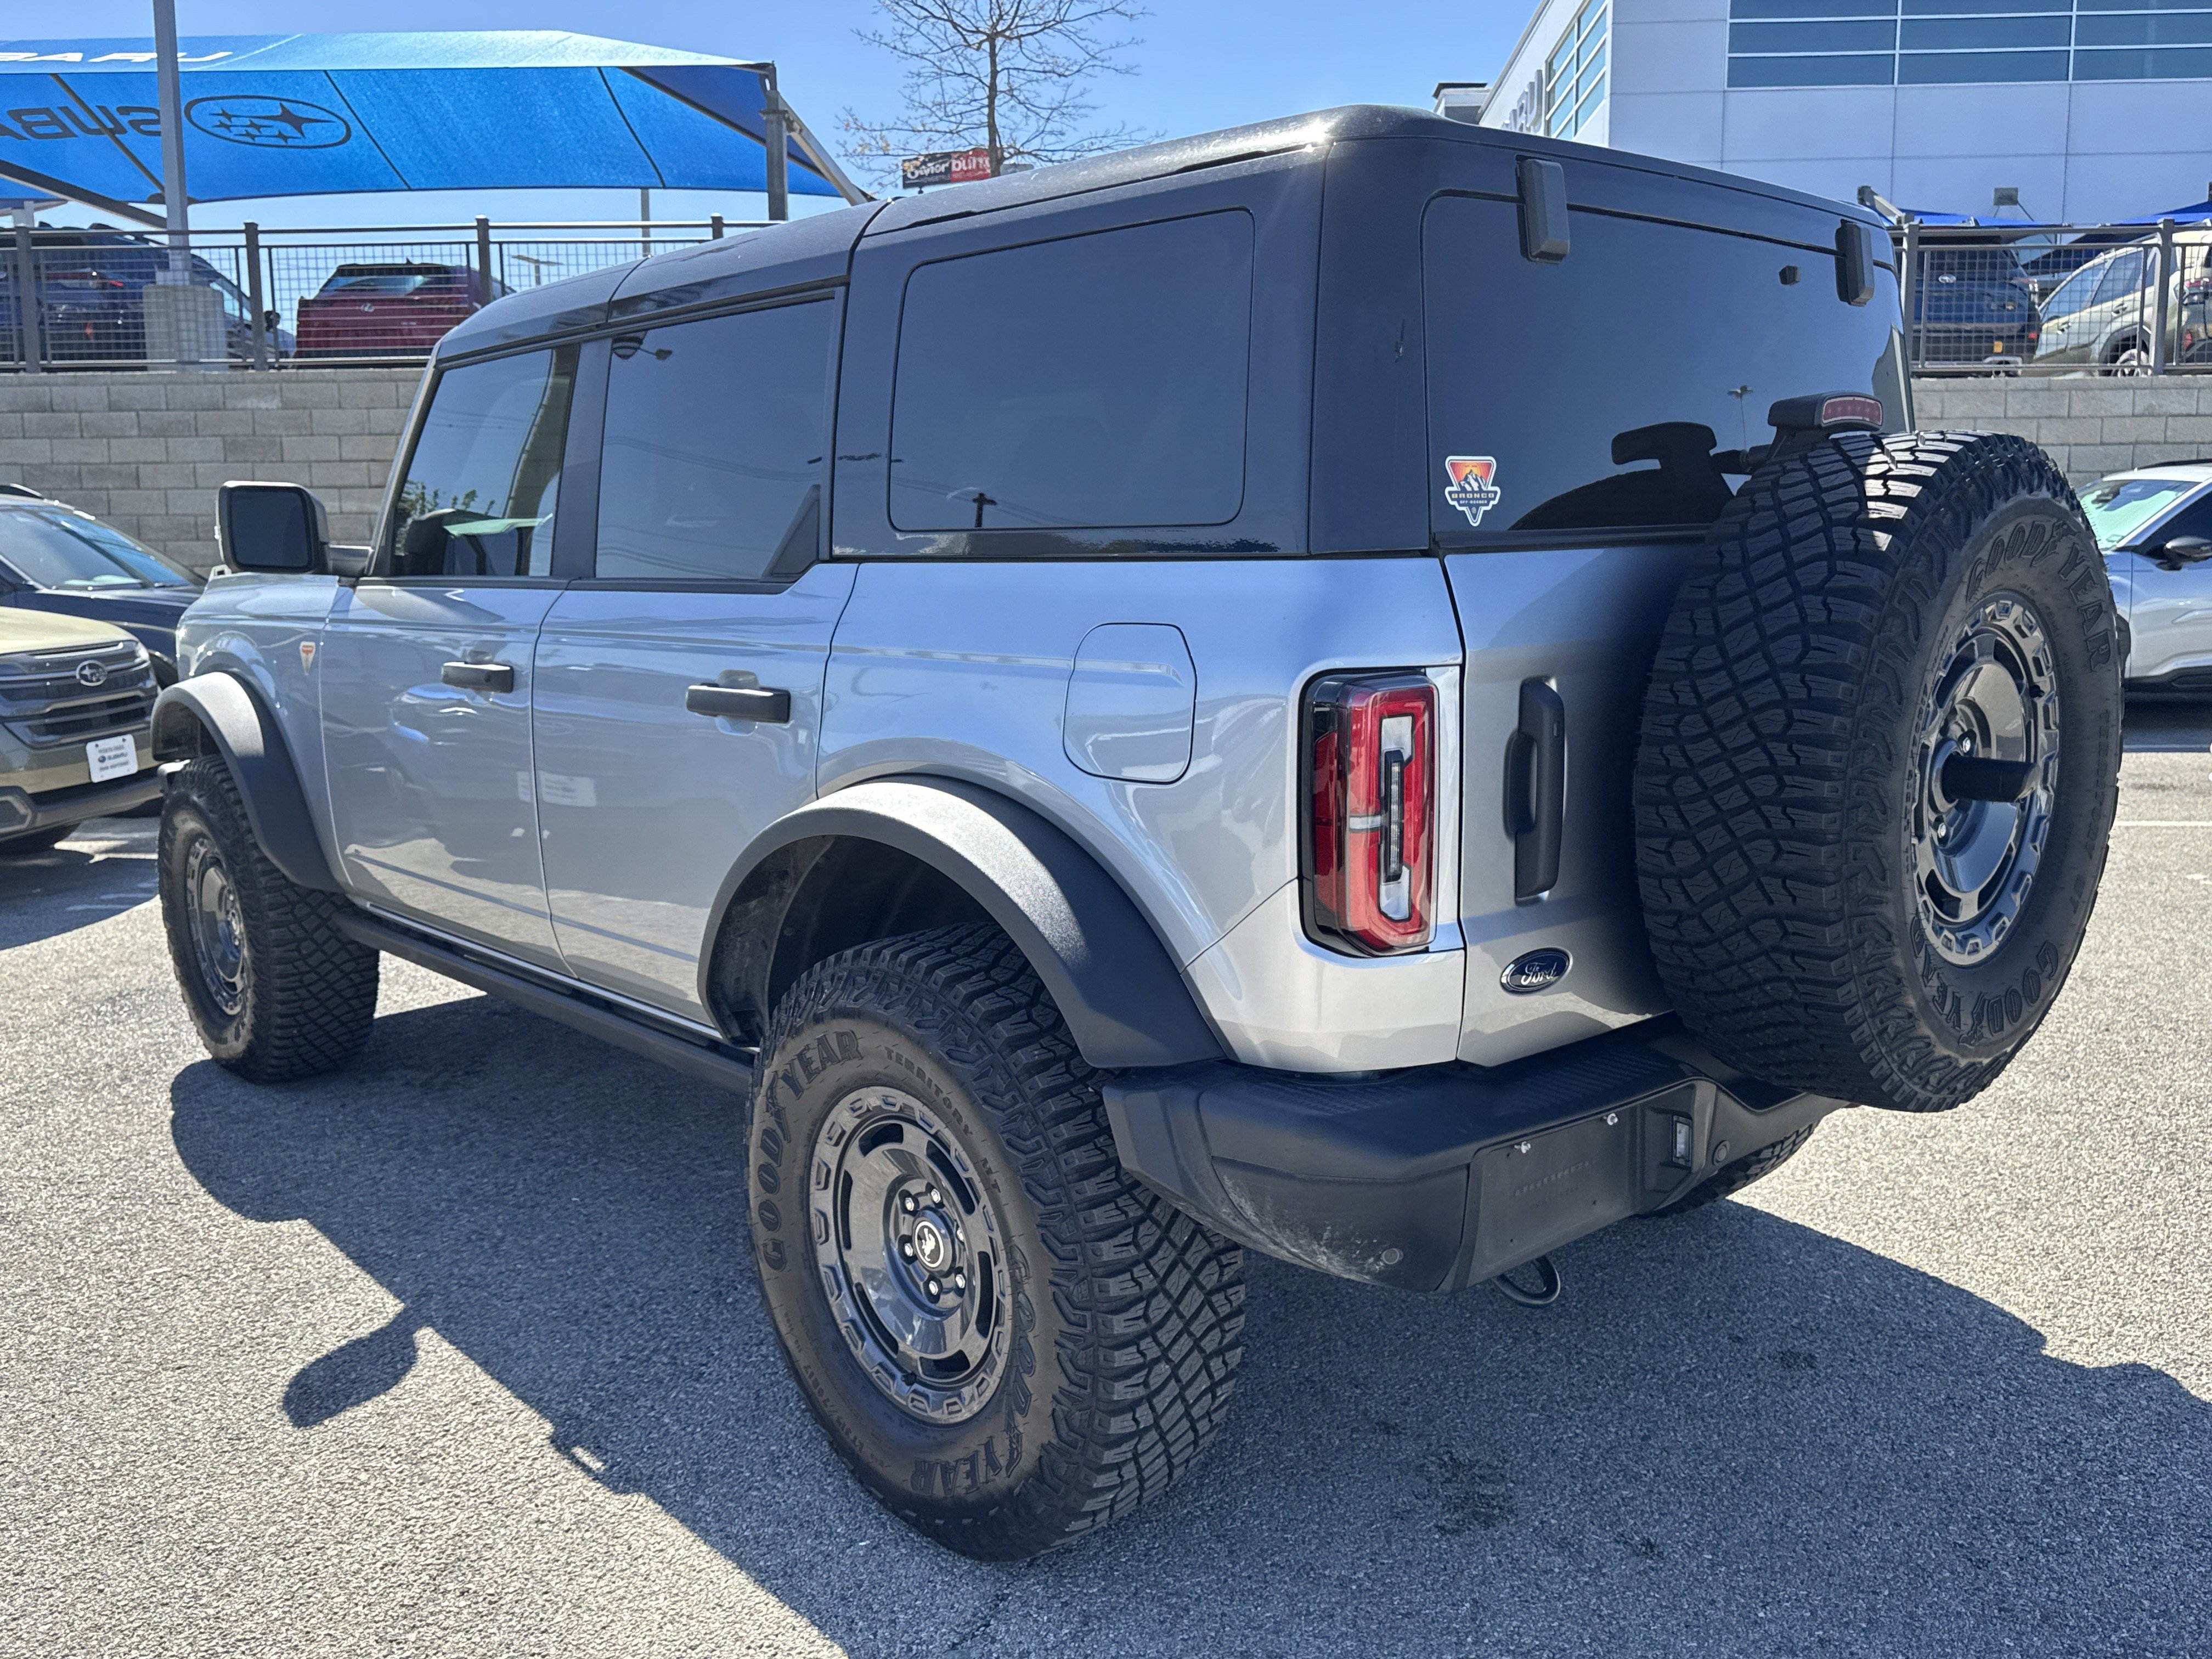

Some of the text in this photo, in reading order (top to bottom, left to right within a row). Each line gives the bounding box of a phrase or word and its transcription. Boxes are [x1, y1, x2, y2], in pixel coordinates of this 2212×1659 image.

[1965, 519, 2111, 672] GOODYEAR
[1520, 962, 1560, 985] Ford
[757, 1028, 864, 1273] GOODYEAR
[884, 1046, 973, 1136] TERRITORY
[910, 1244, 1036, 1497] GOODYEAR
